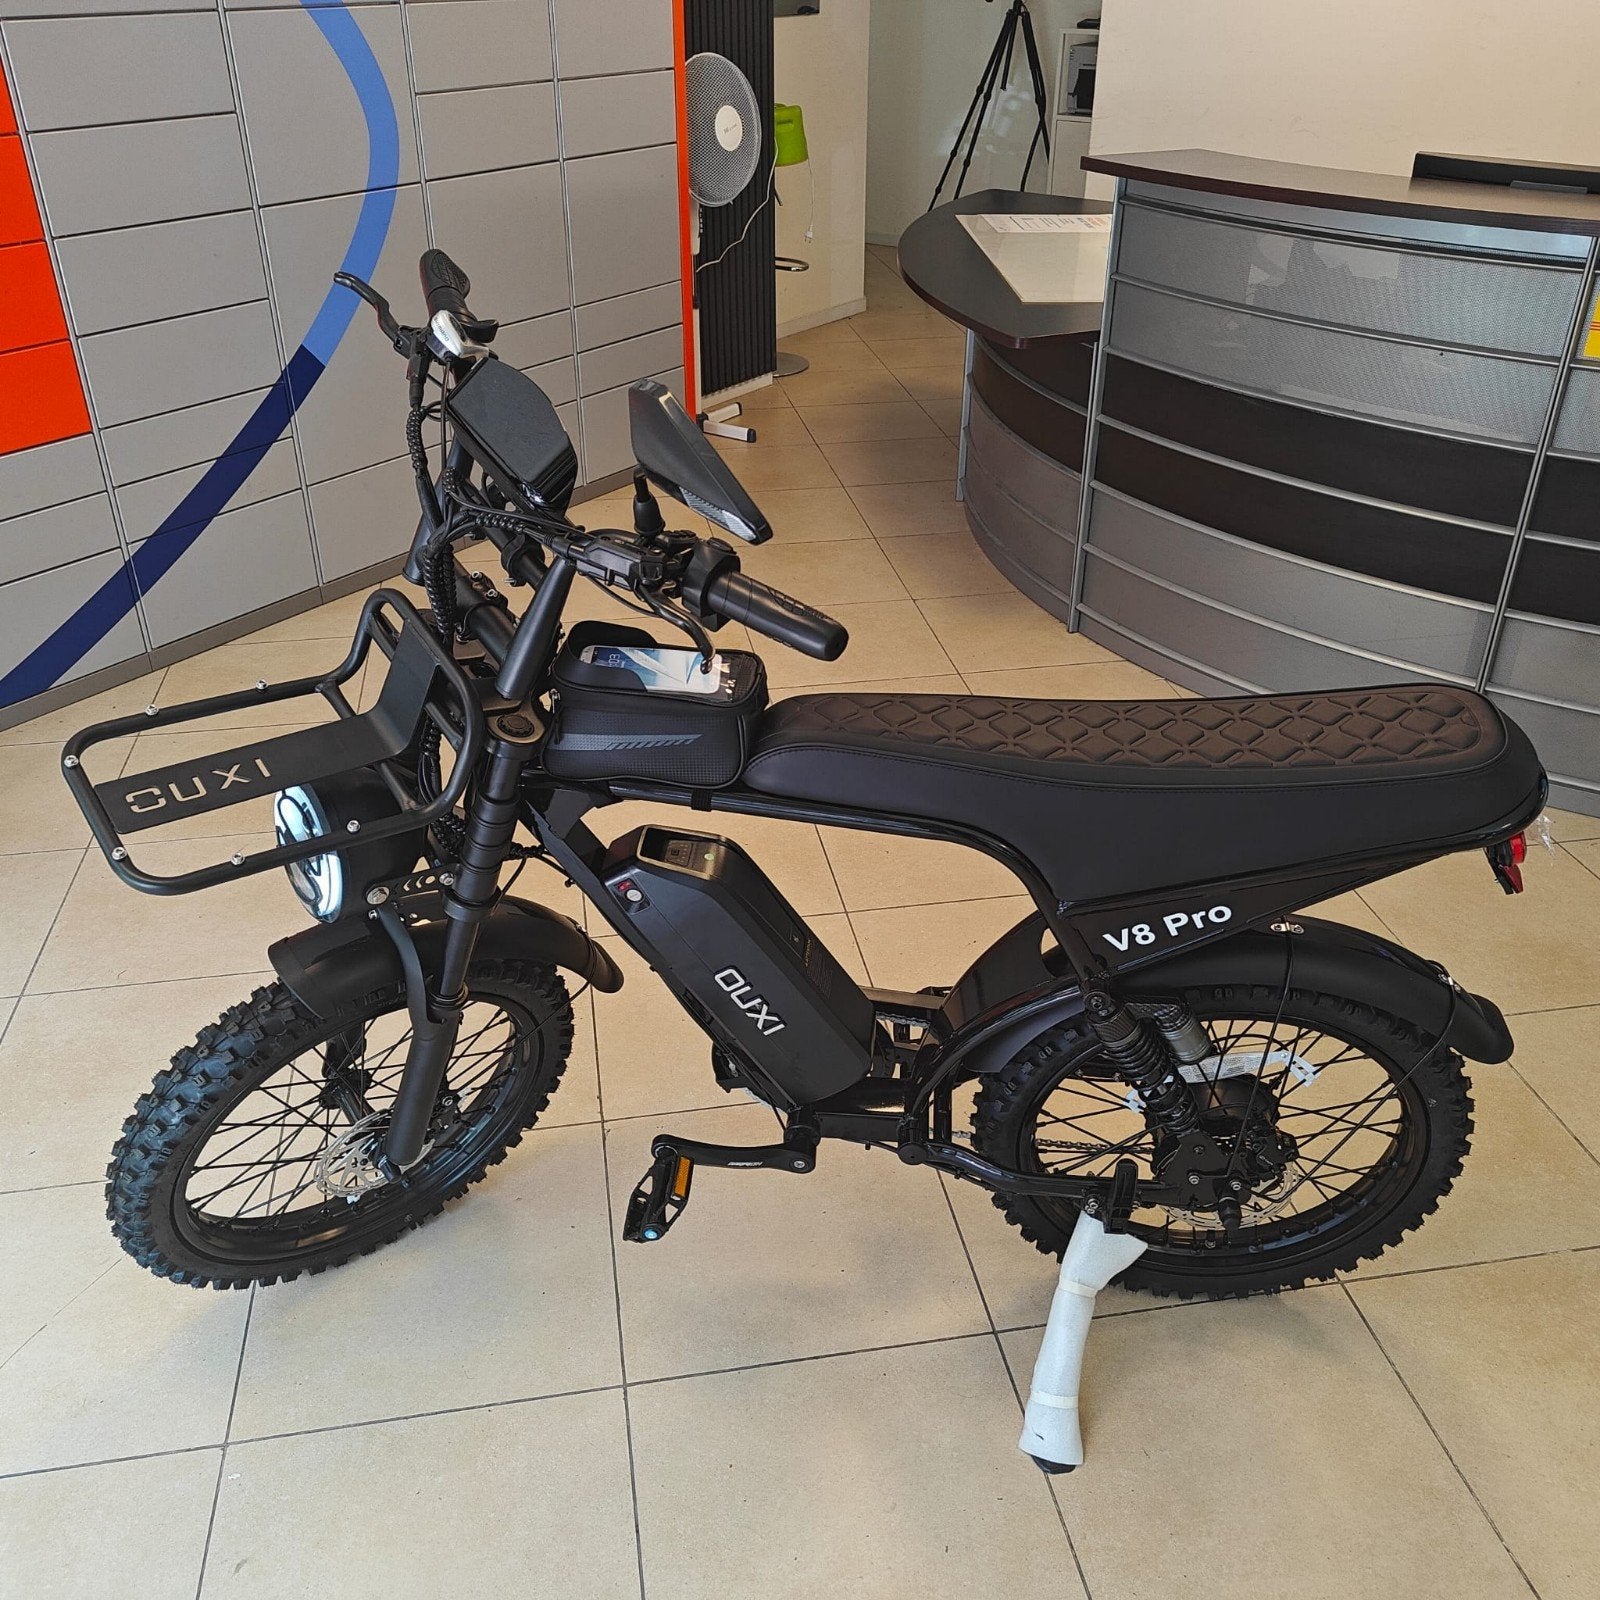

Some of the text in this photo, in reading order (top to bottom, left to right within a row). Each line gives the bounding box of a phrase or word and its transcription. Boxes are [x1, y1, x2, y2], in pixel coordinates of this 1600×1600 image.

[125, 758, 272, 813] OUXI
[1102, 905, 1232, 952] V8 Pro
[714, 968, 786, 1036] OUXI
